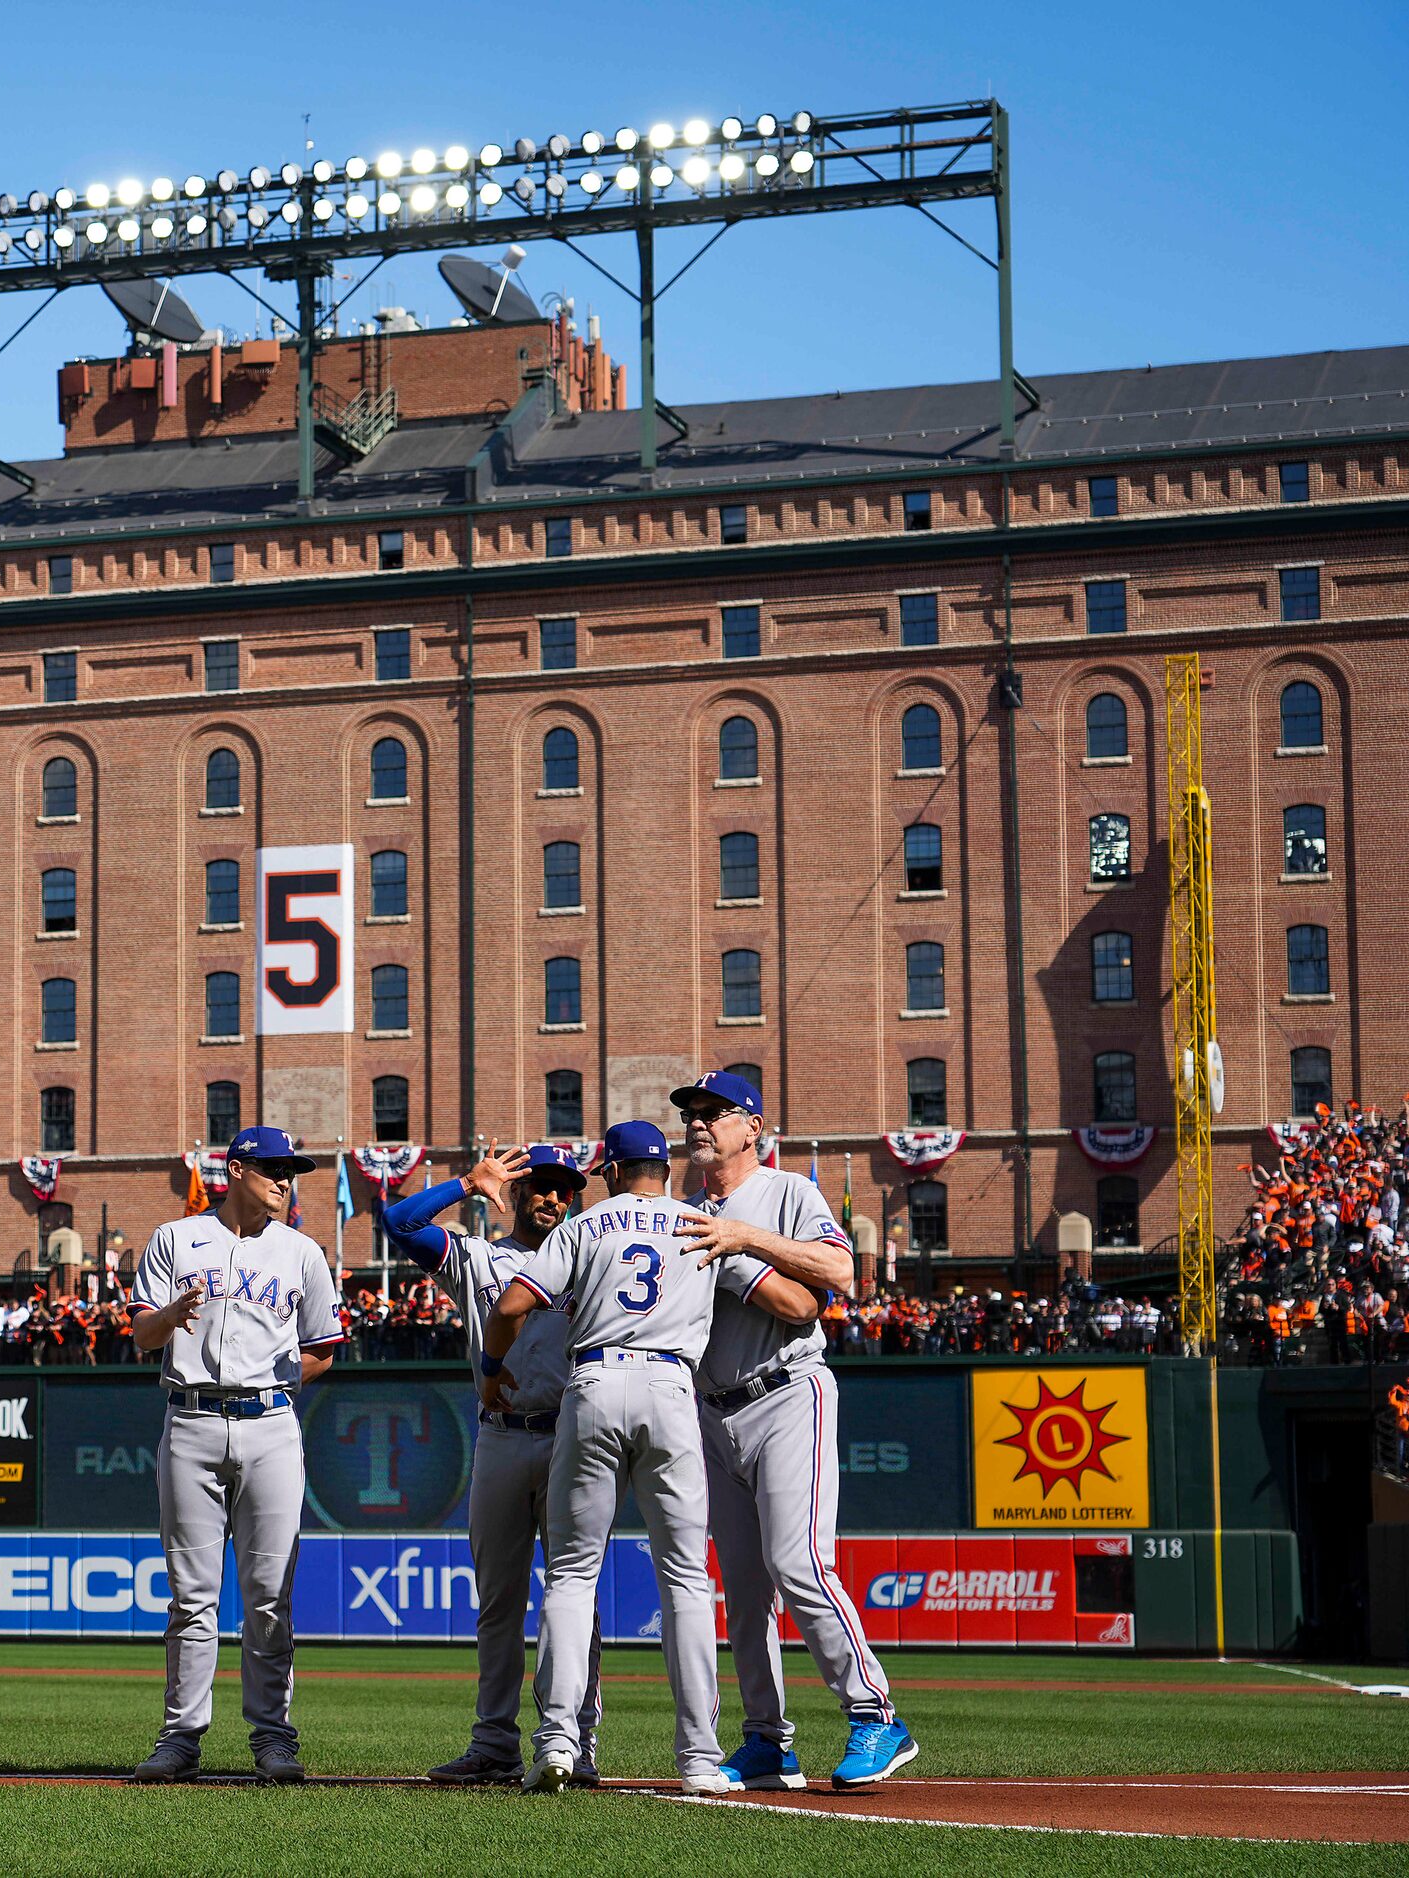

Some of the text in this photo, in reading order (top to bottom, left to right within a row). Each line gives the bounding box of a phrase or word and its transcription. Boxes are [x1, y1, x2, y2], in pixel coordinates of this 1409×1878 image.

[265, 869, 341, 1009] 5
[698, 1072, 717, 1089] T
[553, 1148, 570, 1165] T
[581, 1210, 700, 1243] TAVER
[175, 1266, 303, 1321] TEXAS
[615, 1242, 665, 1316] 3
[1051, 1423, 1074, 1453] L
[336, 1401, 430, 1514] T
[840, 1442, 910, 1473] ES
[992, 1507, 1133, 1521] MARYLAND LOTTERY
[1143, 1537, 1183, 1559] 318
[927, 1569, 1057, 1598] CARROLL
[923, 1598, 1054, 1611] MOTOR FUELS
